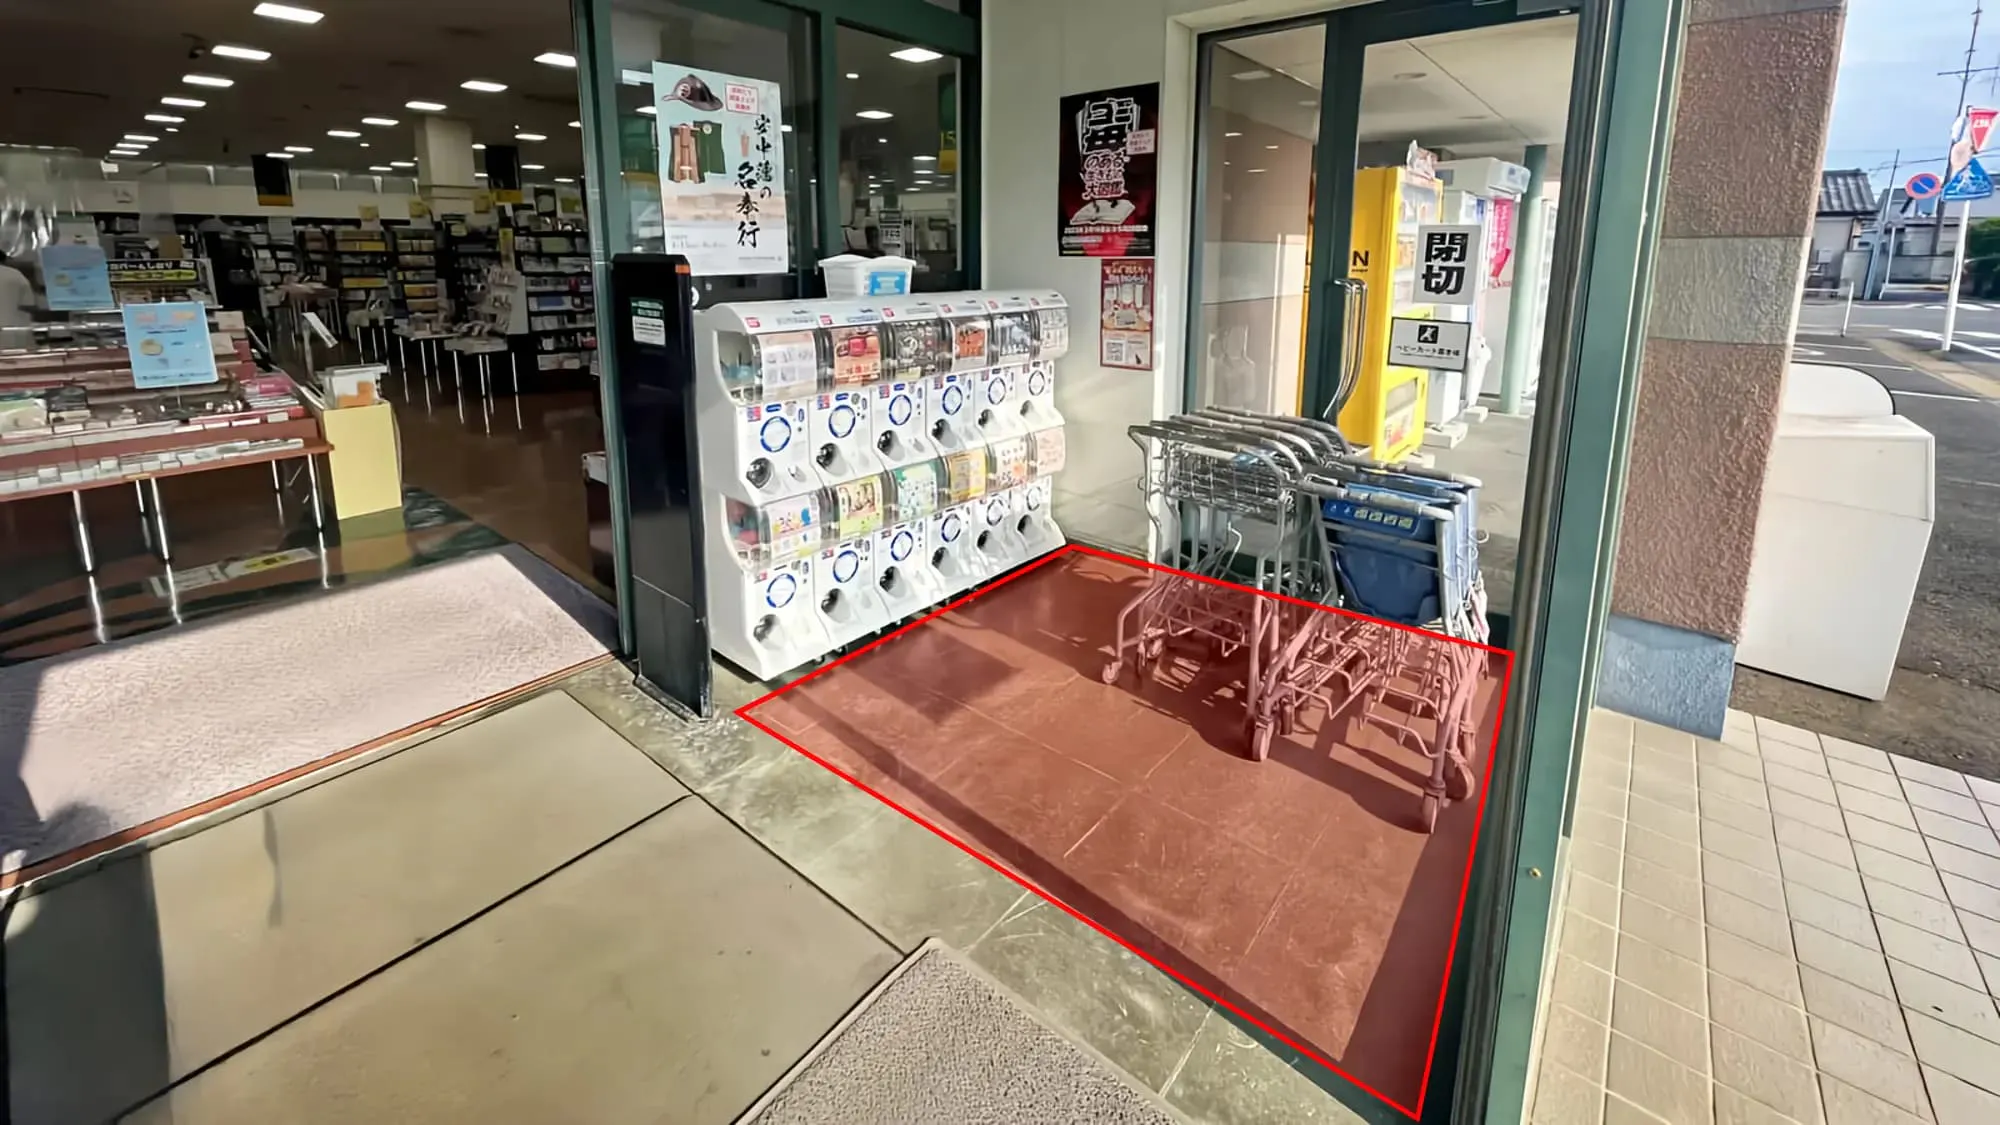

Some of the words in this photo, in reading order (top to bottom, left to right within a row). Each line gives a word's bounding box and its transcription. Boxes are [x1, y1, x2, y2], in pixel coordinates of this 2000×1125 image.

[735, 161, 761, 249] 名奉行
[1421, 232, 1469, 295] 閉切
